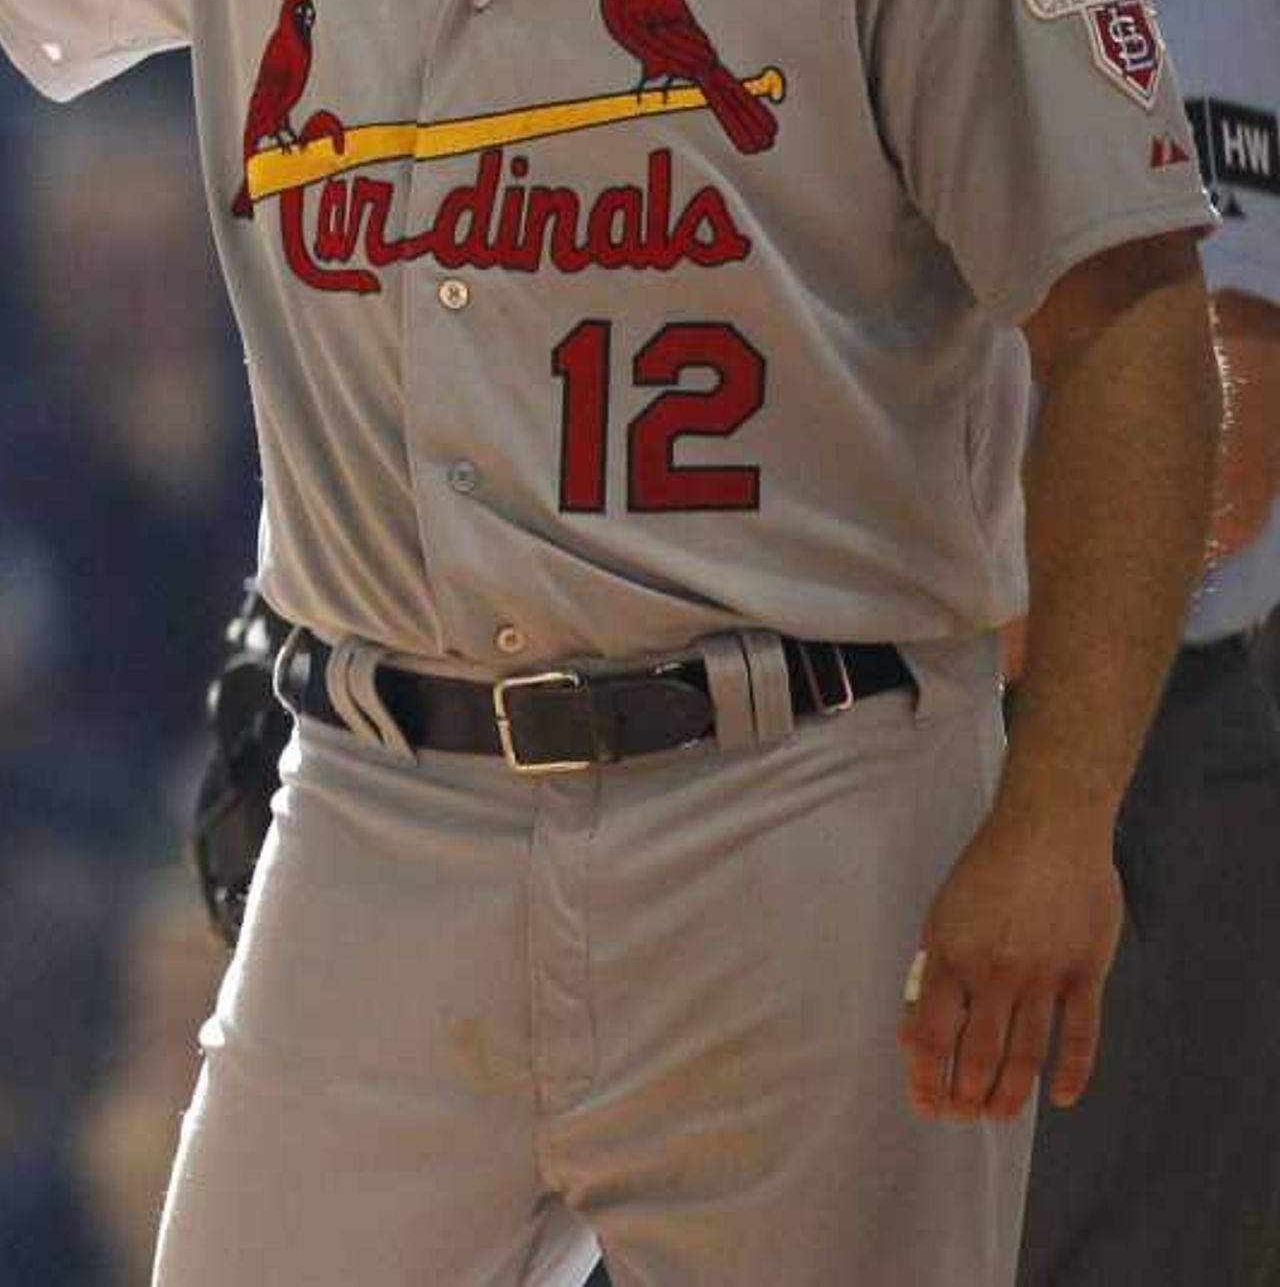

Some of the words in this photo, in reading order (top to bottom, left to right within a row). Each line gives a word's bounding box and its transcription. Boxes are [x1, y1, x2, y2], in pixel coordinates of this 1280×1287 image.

[278, 109, 751, 296] Cardinals
[1222, 119, 1270, 176] HW
[550, 317, 768, 513] 12
